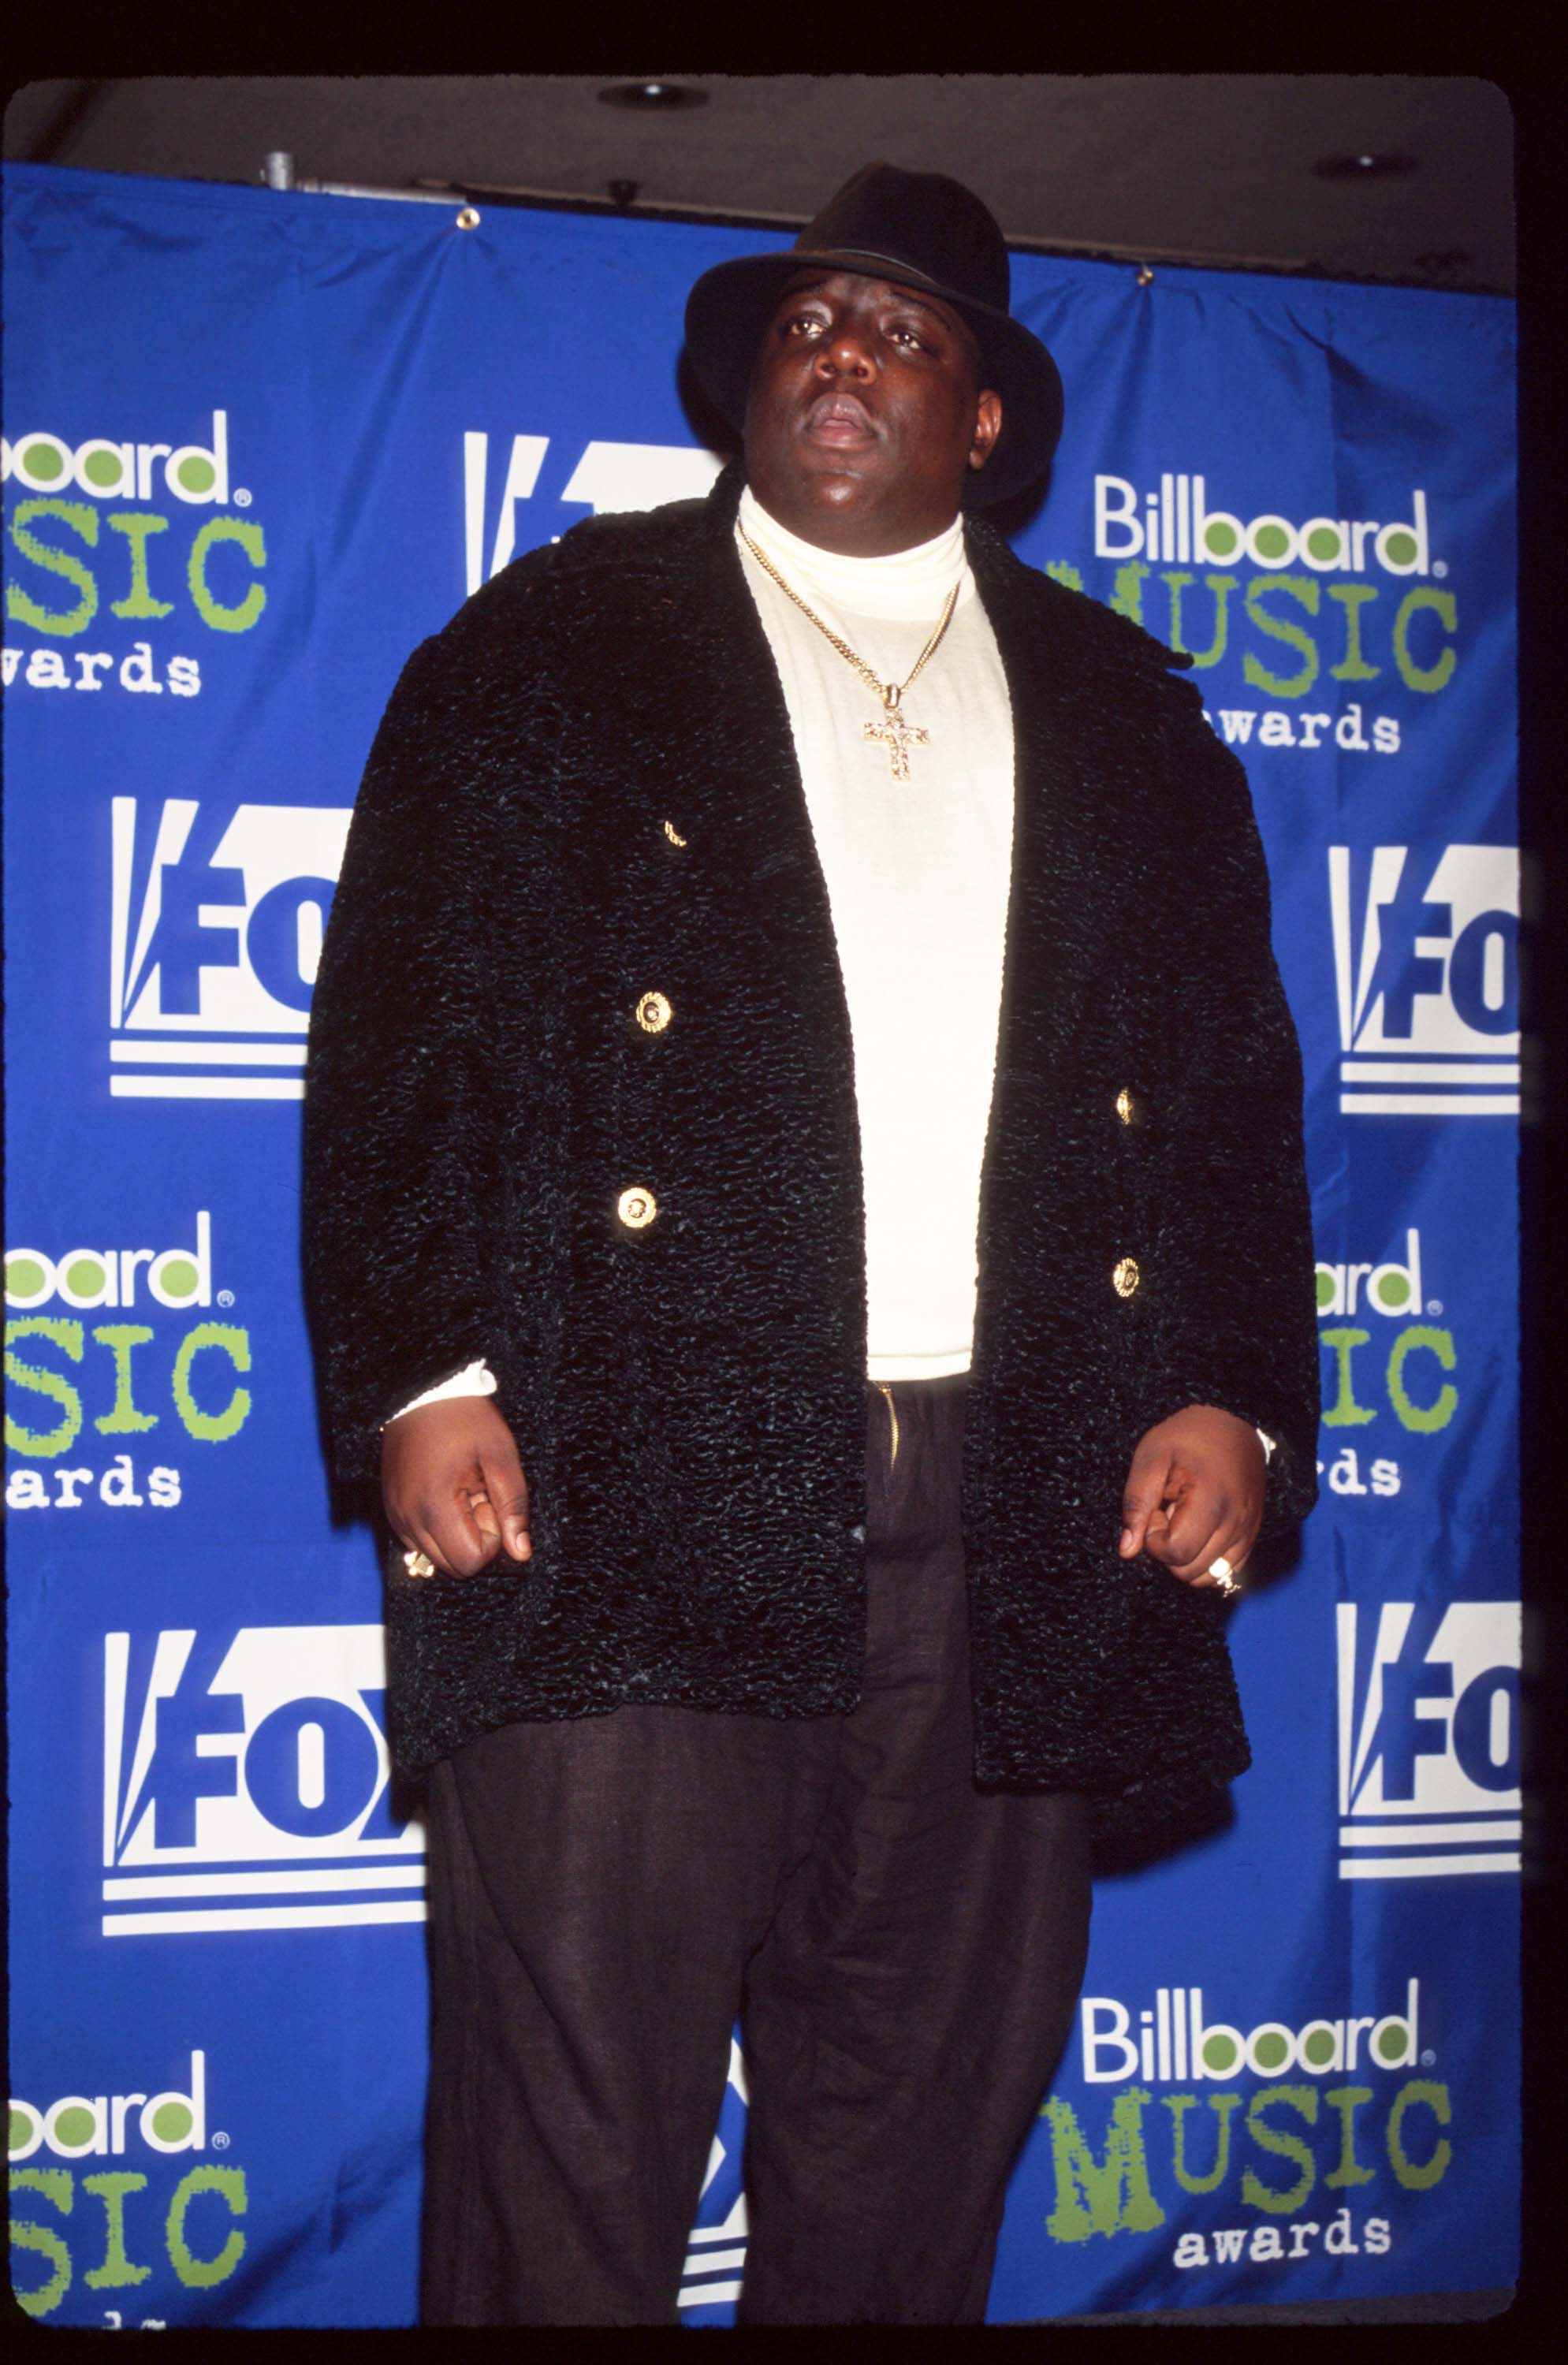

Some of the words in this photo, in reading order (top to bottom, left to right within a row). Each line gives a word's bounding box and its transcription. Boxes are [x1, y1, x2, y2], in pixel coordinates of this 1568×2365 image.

[0, 410, 229, 505] oard
[6, 496, 266, 638] SIC
[1095, 473, 1428, 577] Billboard
[1201, 703, 1402, 754] wards
[4, 1315, 251, 1458] SIC
[1319, 1324, 1458, 1435] IC
[6, 1454, 182, 1509] ards
[1316, 1448, 1401, 1496] ds
[1081, 1977, 1418, 2084] Billboard
[1039, 2079, 1452, 2246] MUSIC
[1172, 2208, 1392, 2269] awards
